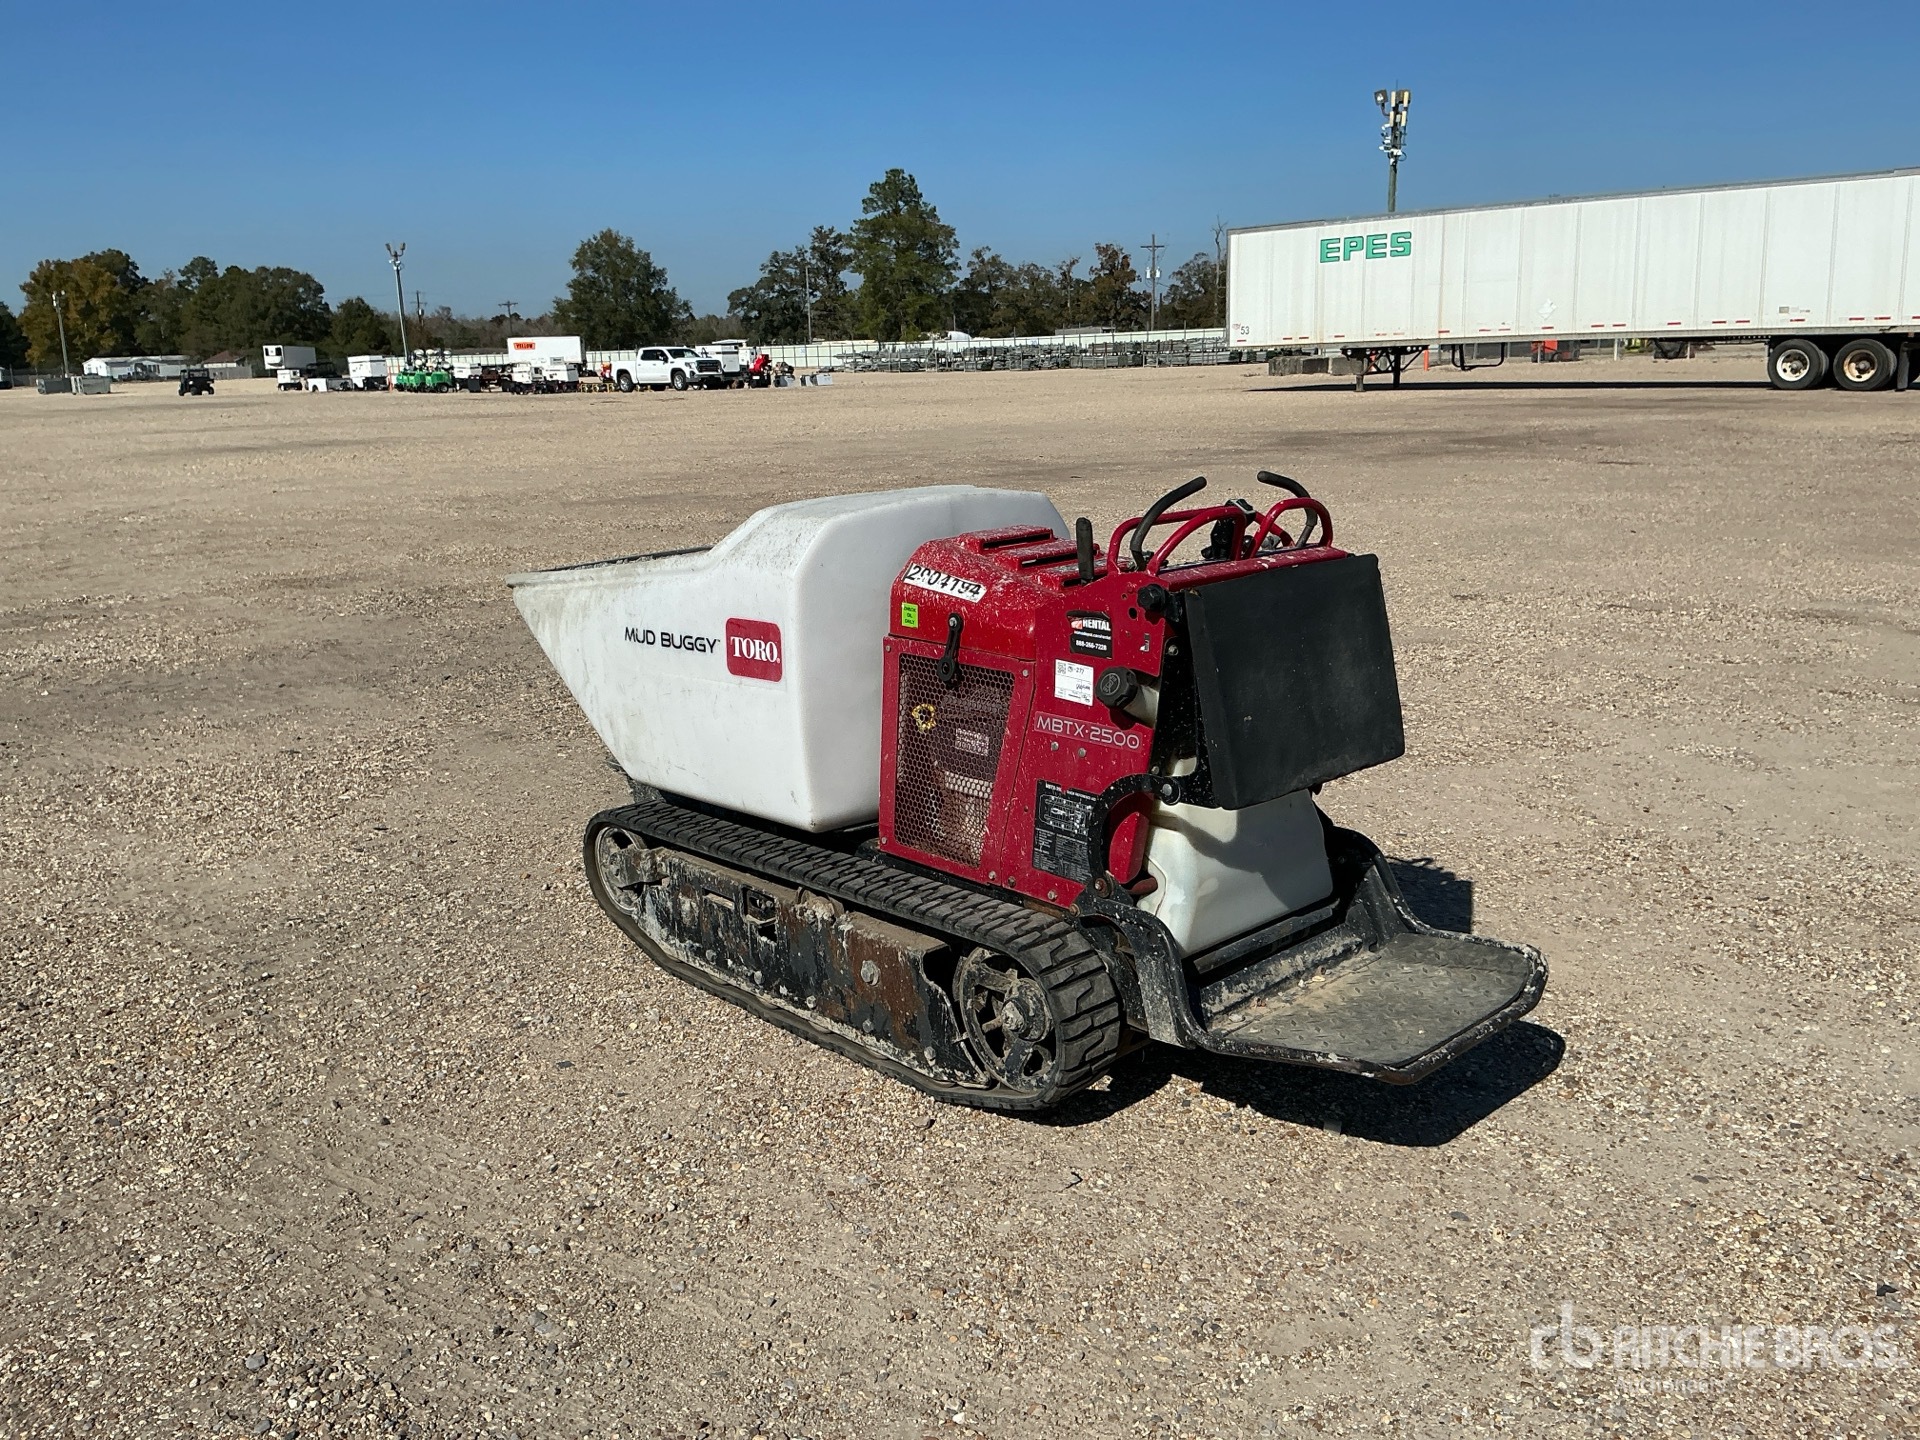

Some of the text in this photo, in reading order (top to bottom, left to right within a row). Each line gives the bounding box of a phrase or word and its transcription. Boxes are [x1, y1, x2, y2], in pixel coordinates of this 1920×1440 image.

[1320, 231, 1412, 263] EPES
[1240, 325, 1250, 335] 53
[1082, 619, 1111, 631] RENTAL
[624, 627, 656, 645] MUD
